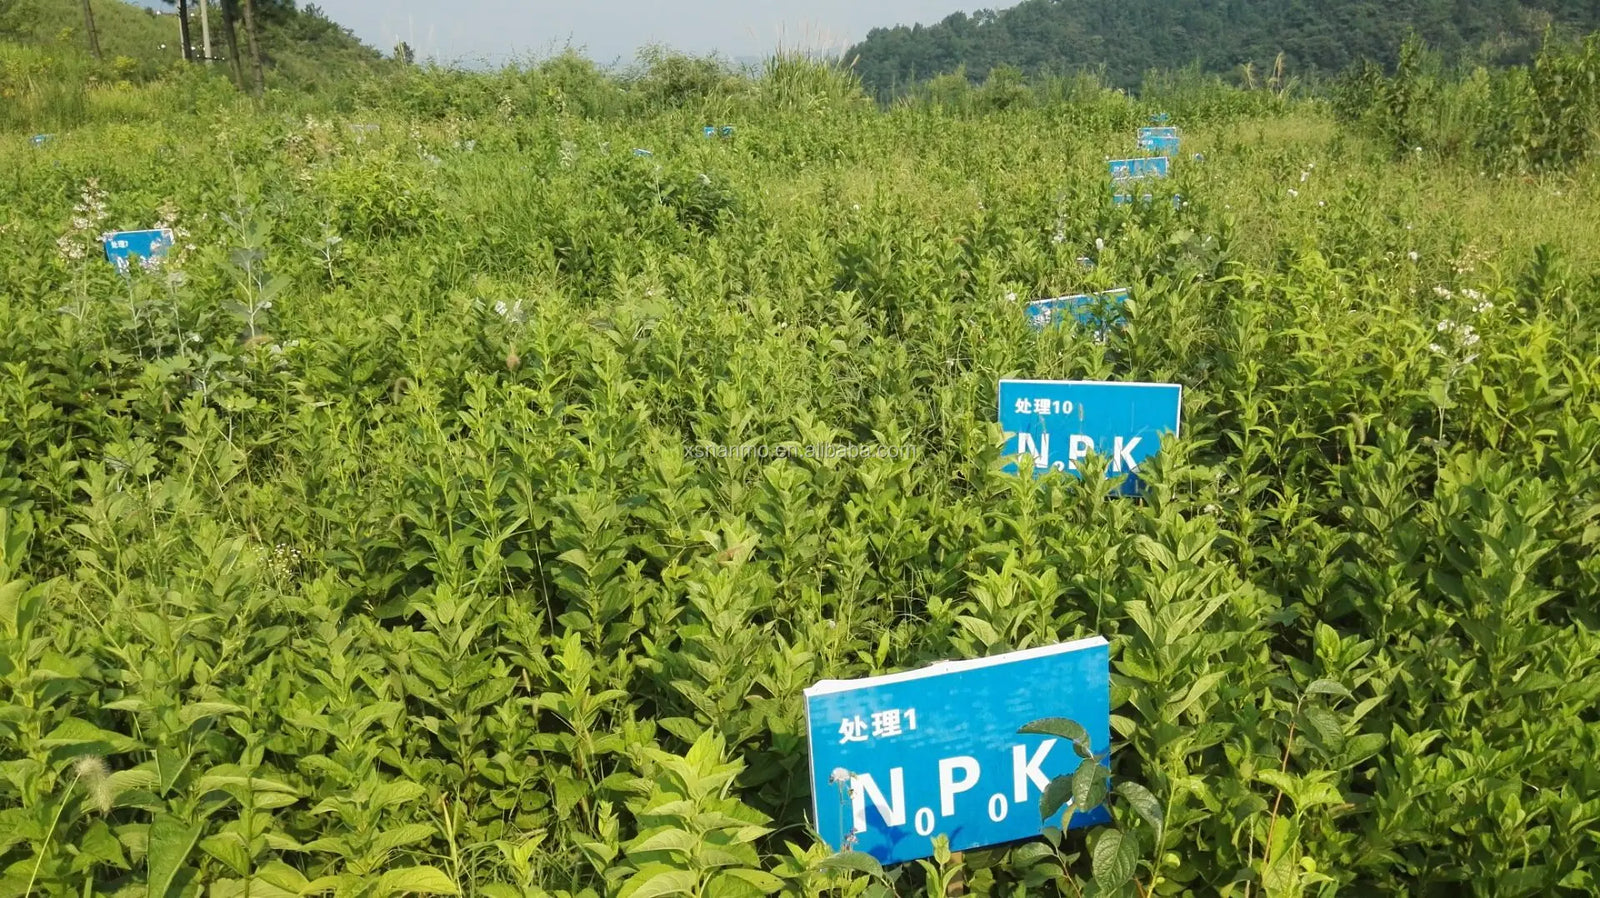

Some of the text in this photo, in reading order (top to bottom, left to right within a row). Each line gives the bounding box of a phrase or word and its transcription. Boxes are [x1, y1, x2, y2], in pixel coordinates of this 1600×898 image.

[1015, 397, 1073, 415] 处理10
[838, 708, 916, 745] 处理1
[850, 738, 1076, 836] N0P0K
